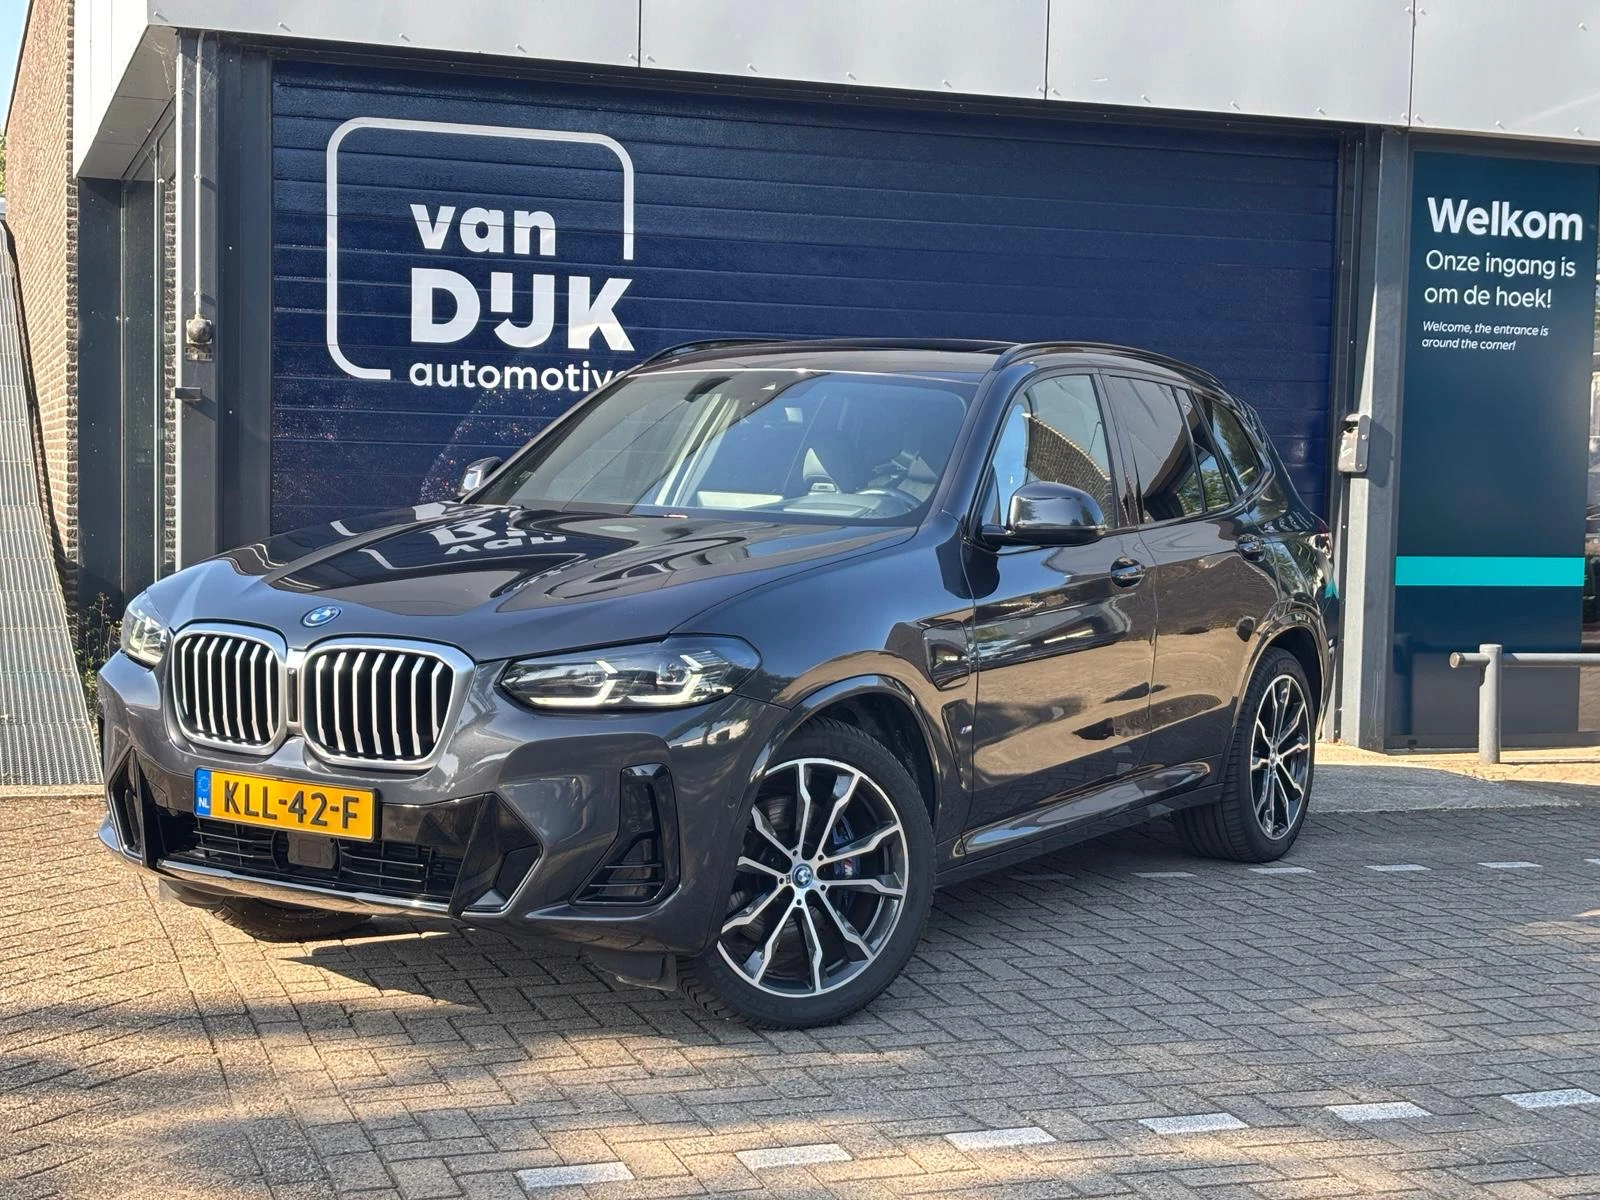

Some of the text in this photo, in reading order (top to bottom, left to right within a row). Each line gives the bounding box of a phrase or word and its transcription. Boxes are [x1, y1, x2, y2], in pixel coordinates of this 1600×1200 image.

[410, 203, 556, 256] van
[1427, 197, 1583, 241] Welkom
[1426, 249, 1577, 279] Onze ingang is
[411, 267, 635, 351] DIJK
[1424, 285, 1552, 309] om de hoek!
[1422, 320, 1549, 337] Welcome, the entrance is
[1421, 338, 1517, 351] around the corner!
[409, 359, 626, 392] automotiv
[198, 796, 210, 809] NL
[224, 780, 360, 829] KLL-42-F
